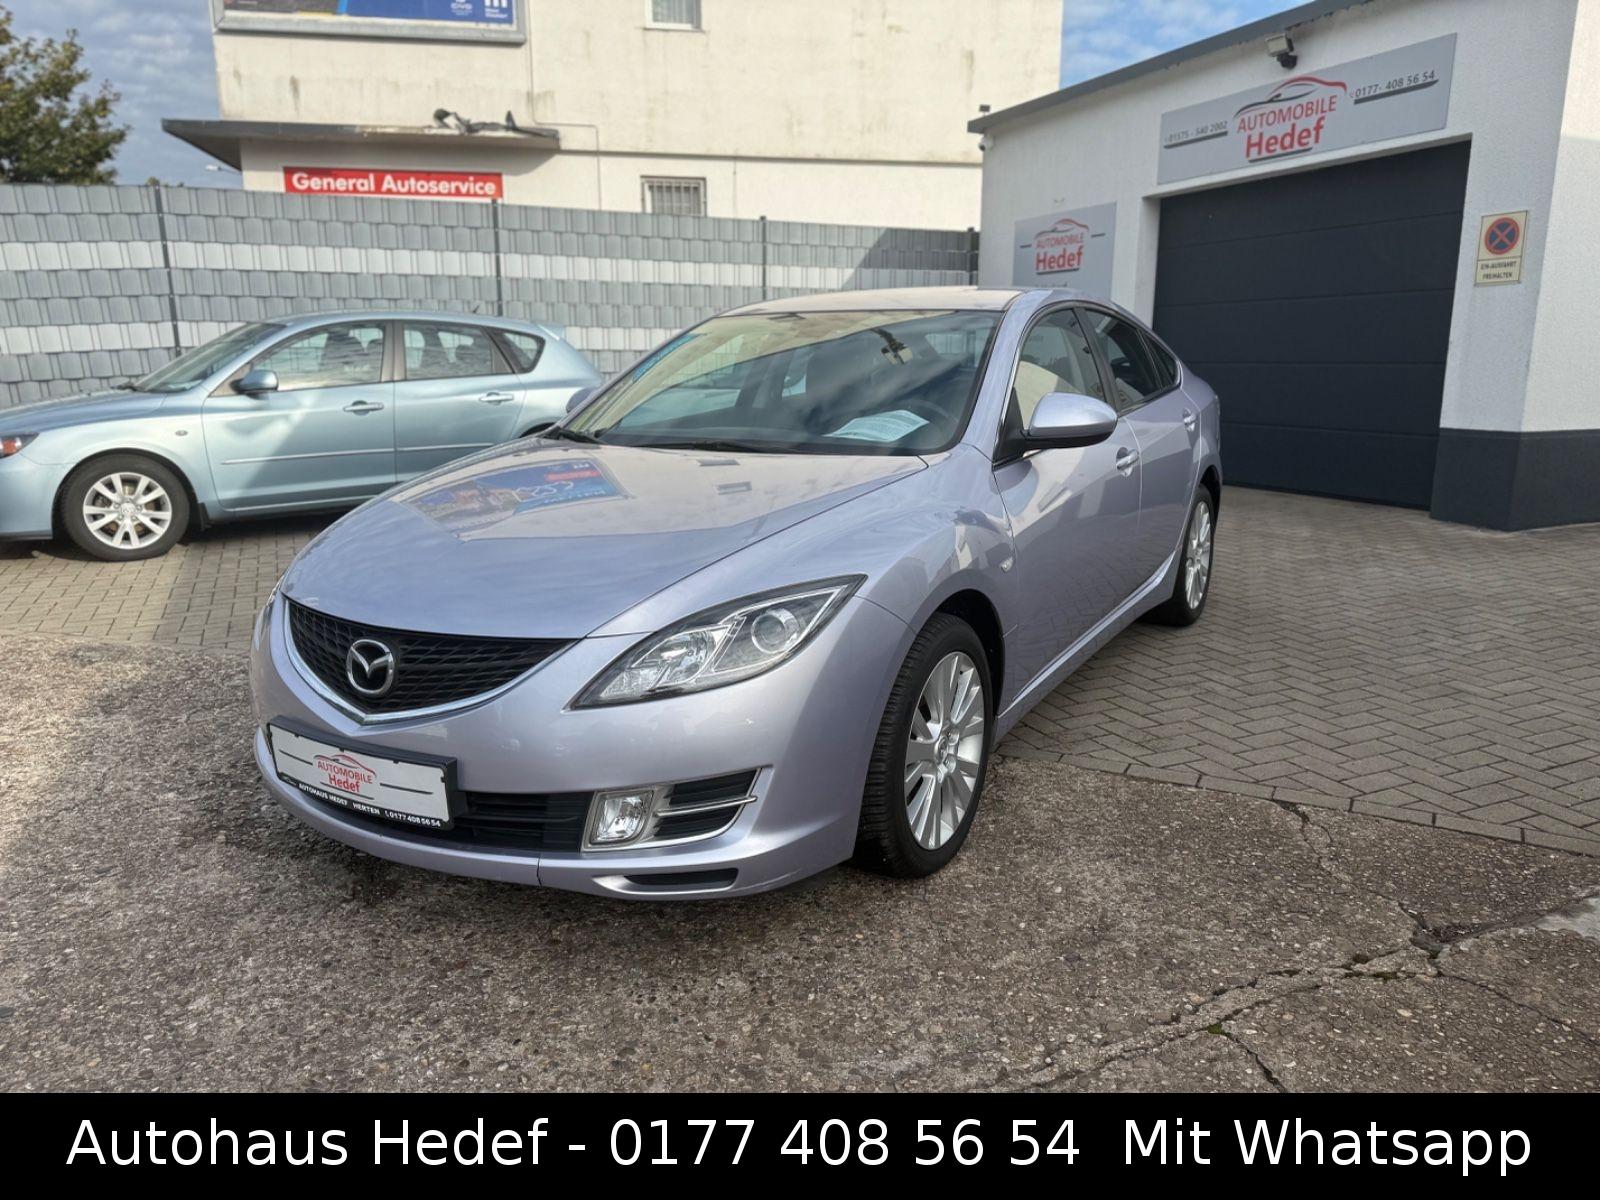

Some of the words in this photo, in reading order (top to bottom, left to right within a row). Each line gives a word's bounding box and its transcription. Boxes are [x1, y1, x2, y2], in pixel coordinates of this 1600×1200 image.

[1385, 77, 1404, 89] 408
[1407, 73, 1419, 85] 56
[1422, 70, 1435, 81] 54
[1237, 95, 1337, 133] AUTOMOBILE
[1245, 116, 1326, 158] Hedef
[291, 172, 375, 192] General
[381, 174, 496, 195] Autoservice
[1036, 232, 1084, 249] AUTOMOBILE
[1035, 245, 1084, 271] Hedef
[317, 760, 373, 784] AUTOMOBILE
[328, 773, 360, 792] Hedef
[299, 783, 328, 799] AUTOHAUS
[329, 794, 348, 806] HEDEF
[352, 802, 380, 815] HERTEN
